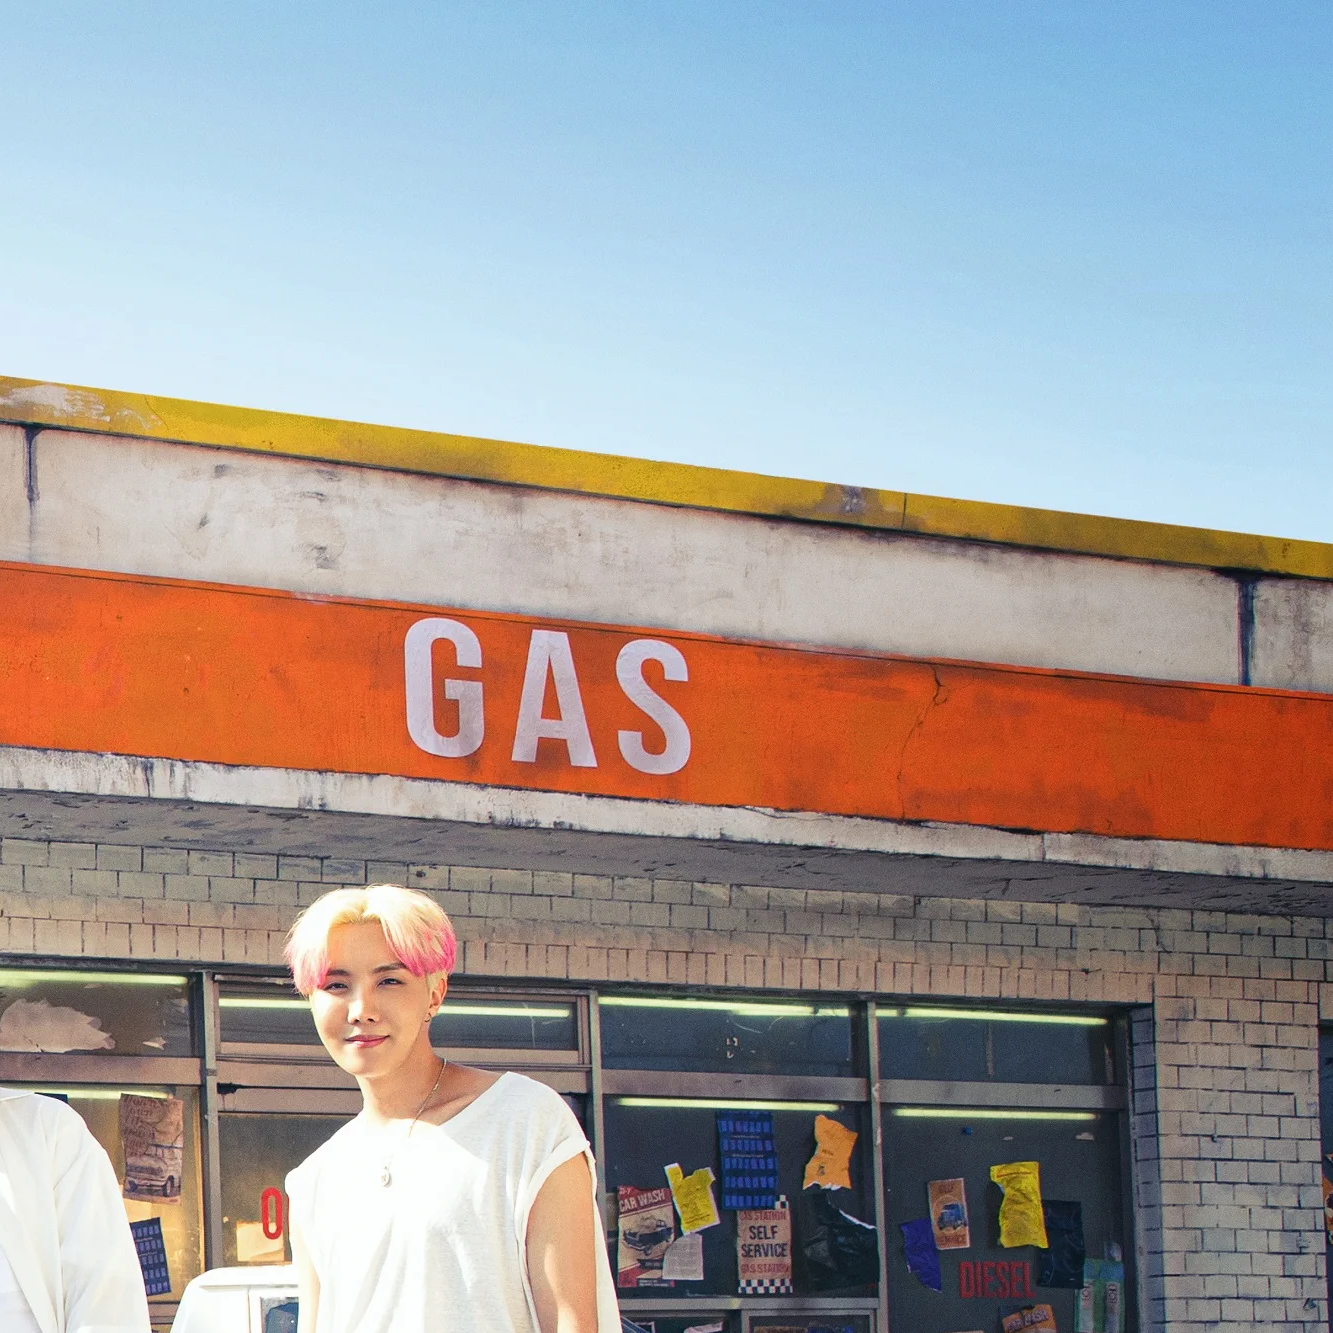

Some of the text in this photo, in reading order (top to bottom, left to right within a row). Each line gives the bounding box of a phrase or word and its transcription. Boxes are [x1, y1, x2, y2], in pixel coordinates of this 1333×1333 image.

[404, 617, 691, 775] GAS
[619, 1189, 666, 1213] CAR WASH
[749, 1225, 778, 1240] SELF
[741, 1243, 788, 1258] SERVICE
[959, 1261, 1036, 1299] DIESEL
